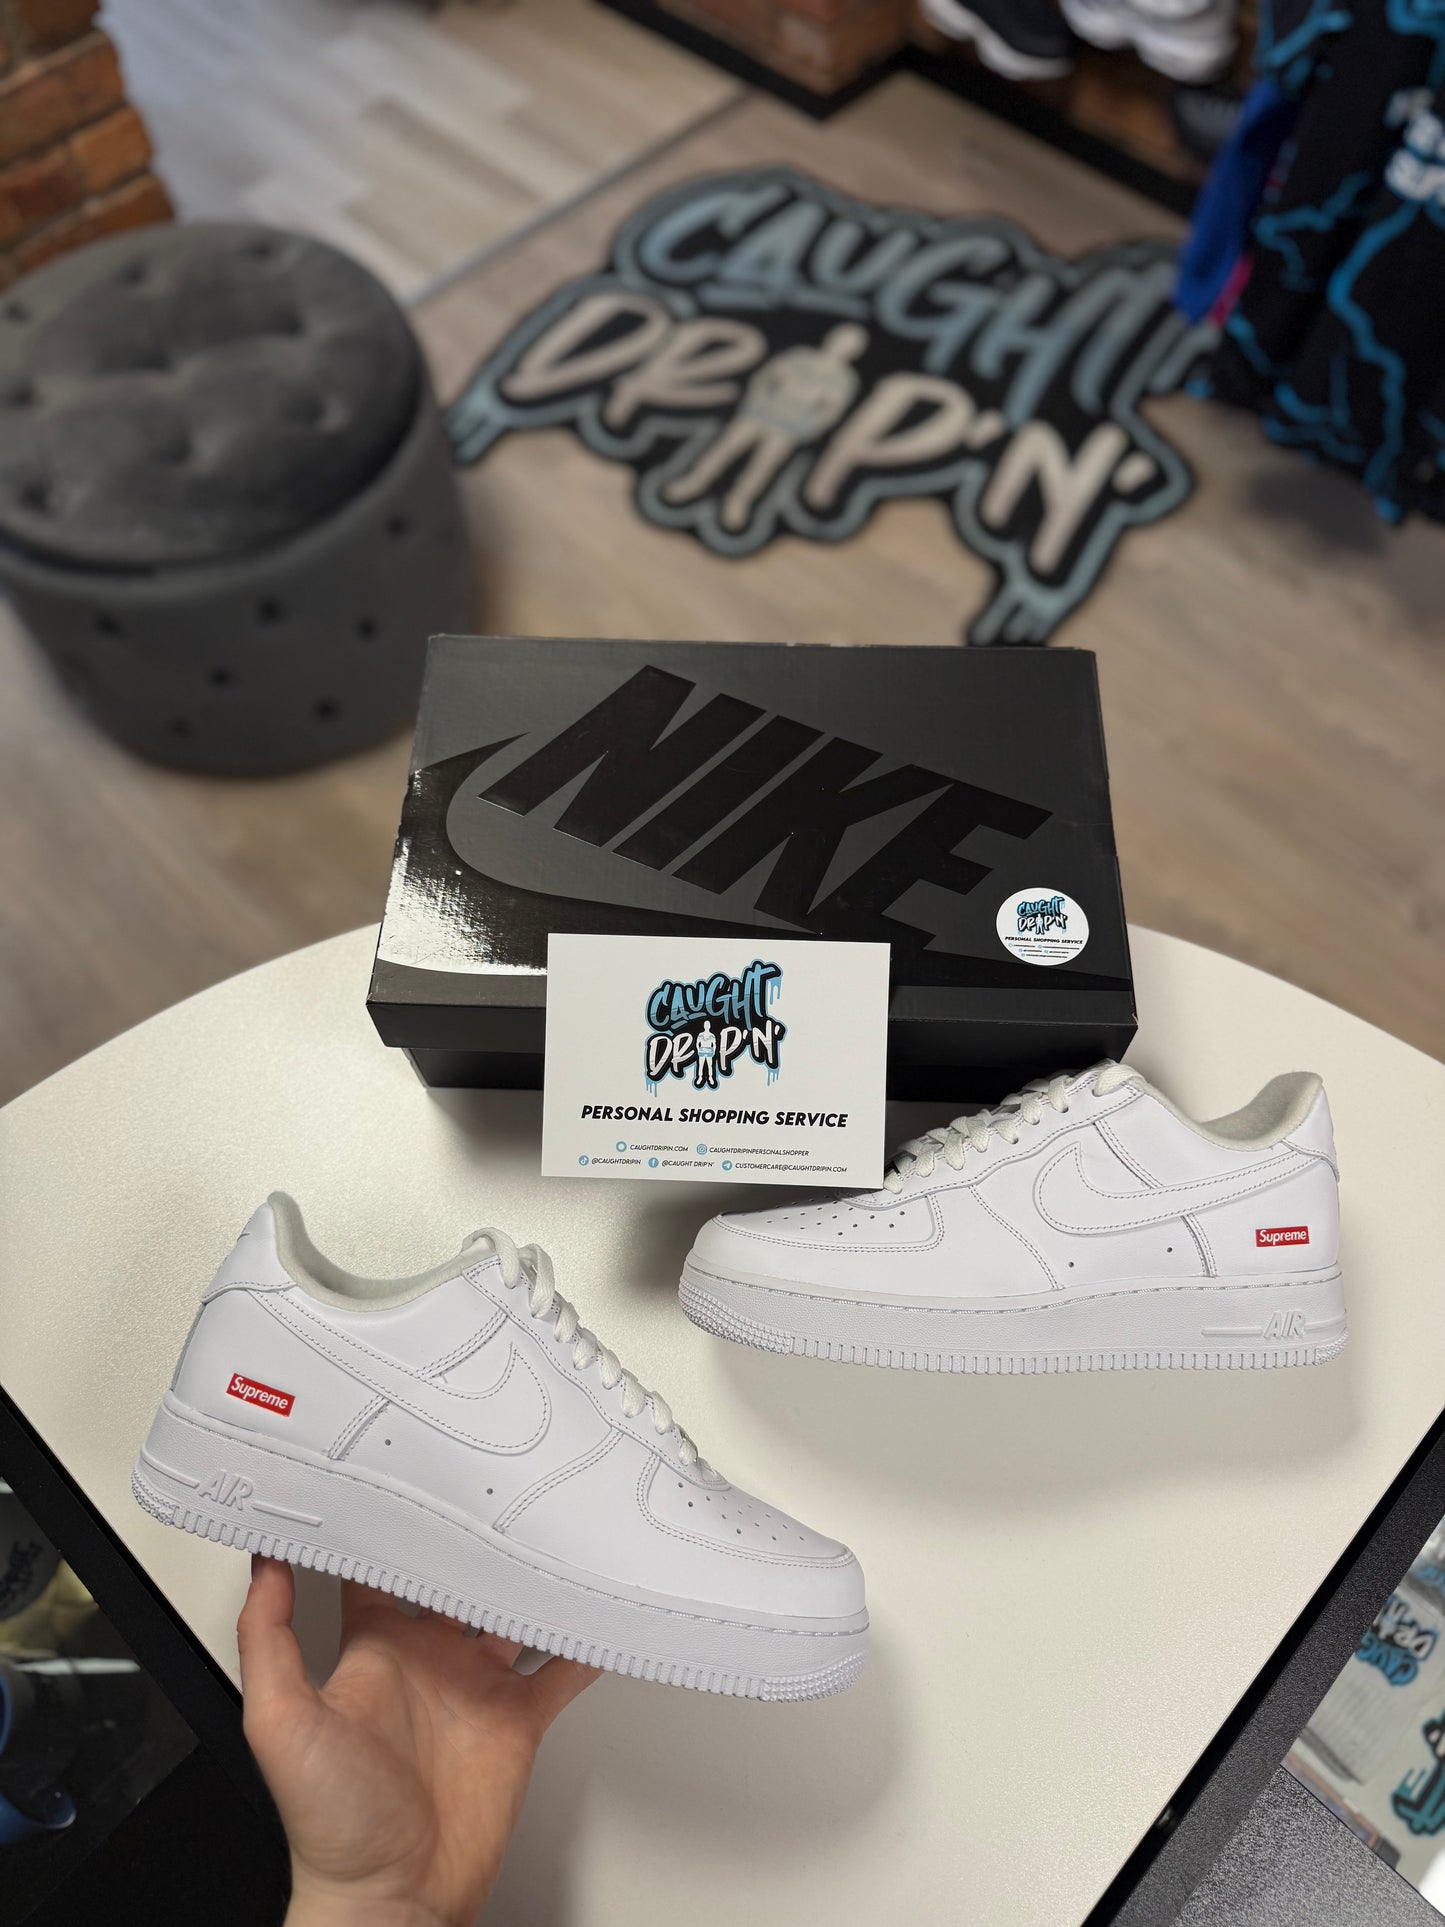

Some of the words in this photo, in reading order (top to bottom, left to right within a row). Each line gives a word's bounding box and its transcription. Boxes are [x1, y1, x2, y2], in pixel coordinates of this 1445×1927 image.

[477, 664, 1053, 952] NIKE
[1017, 896, 1065, 917] CAUGHT
[649, 962, 777, 1031] CAUGHT
[581, 1105, 673, 1121] PERSONAL
[678, 1108, 770, 1125] SHOPPING
[774, 1111, 848, 1128] SERVICE
[629, 1144, 689, 1152] CAUGHTDRIPIN.COM
[709, 1146, 810, 1157] CAUGHTDRIPINPERSONALSHOPPER
[591, 1157, 642, 1165] @CAUGHTDRIPIN
[661, 1159, 693, 1167] @CAUGHT
[735, 1162, 848, 1173] CUSTOMERCARE@CAUGHTDRIPIN.COM
[1258, 1229, 1307, 1246] Supreme
[1263, 1309, 1306, 1340] AIR
[230, 1375, 289, 1410] Supreme
[198, 1468, 254, 1511] AIR
